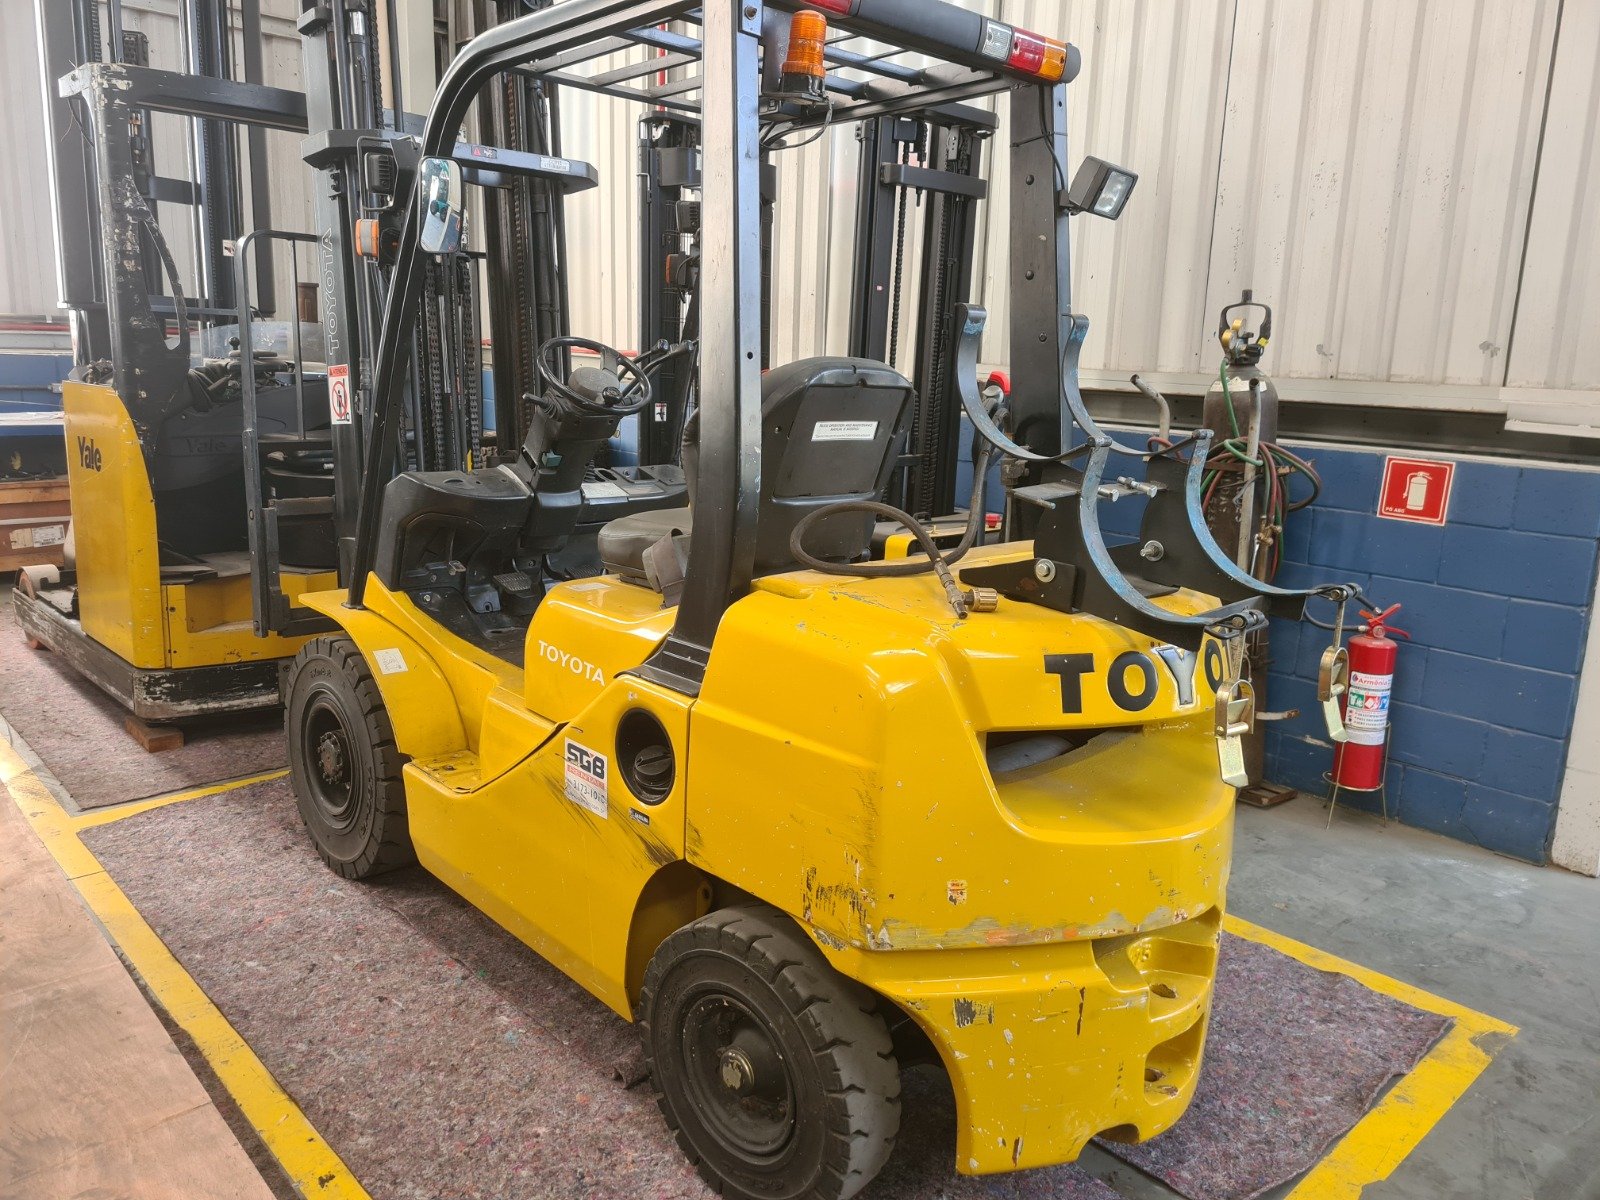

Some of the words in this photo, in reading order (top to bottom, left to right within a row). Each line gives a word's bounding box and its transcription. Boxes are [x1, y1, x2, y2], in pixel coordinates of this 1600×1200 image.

[322, 228, 339, 355] TOYOTA
[77, 436, 102, 472] Yale
[185, 437, 227, 453] Yale
[538, 640, 605, 687] TOYOTA
[1044, 638, 1231, 714] TOYO
